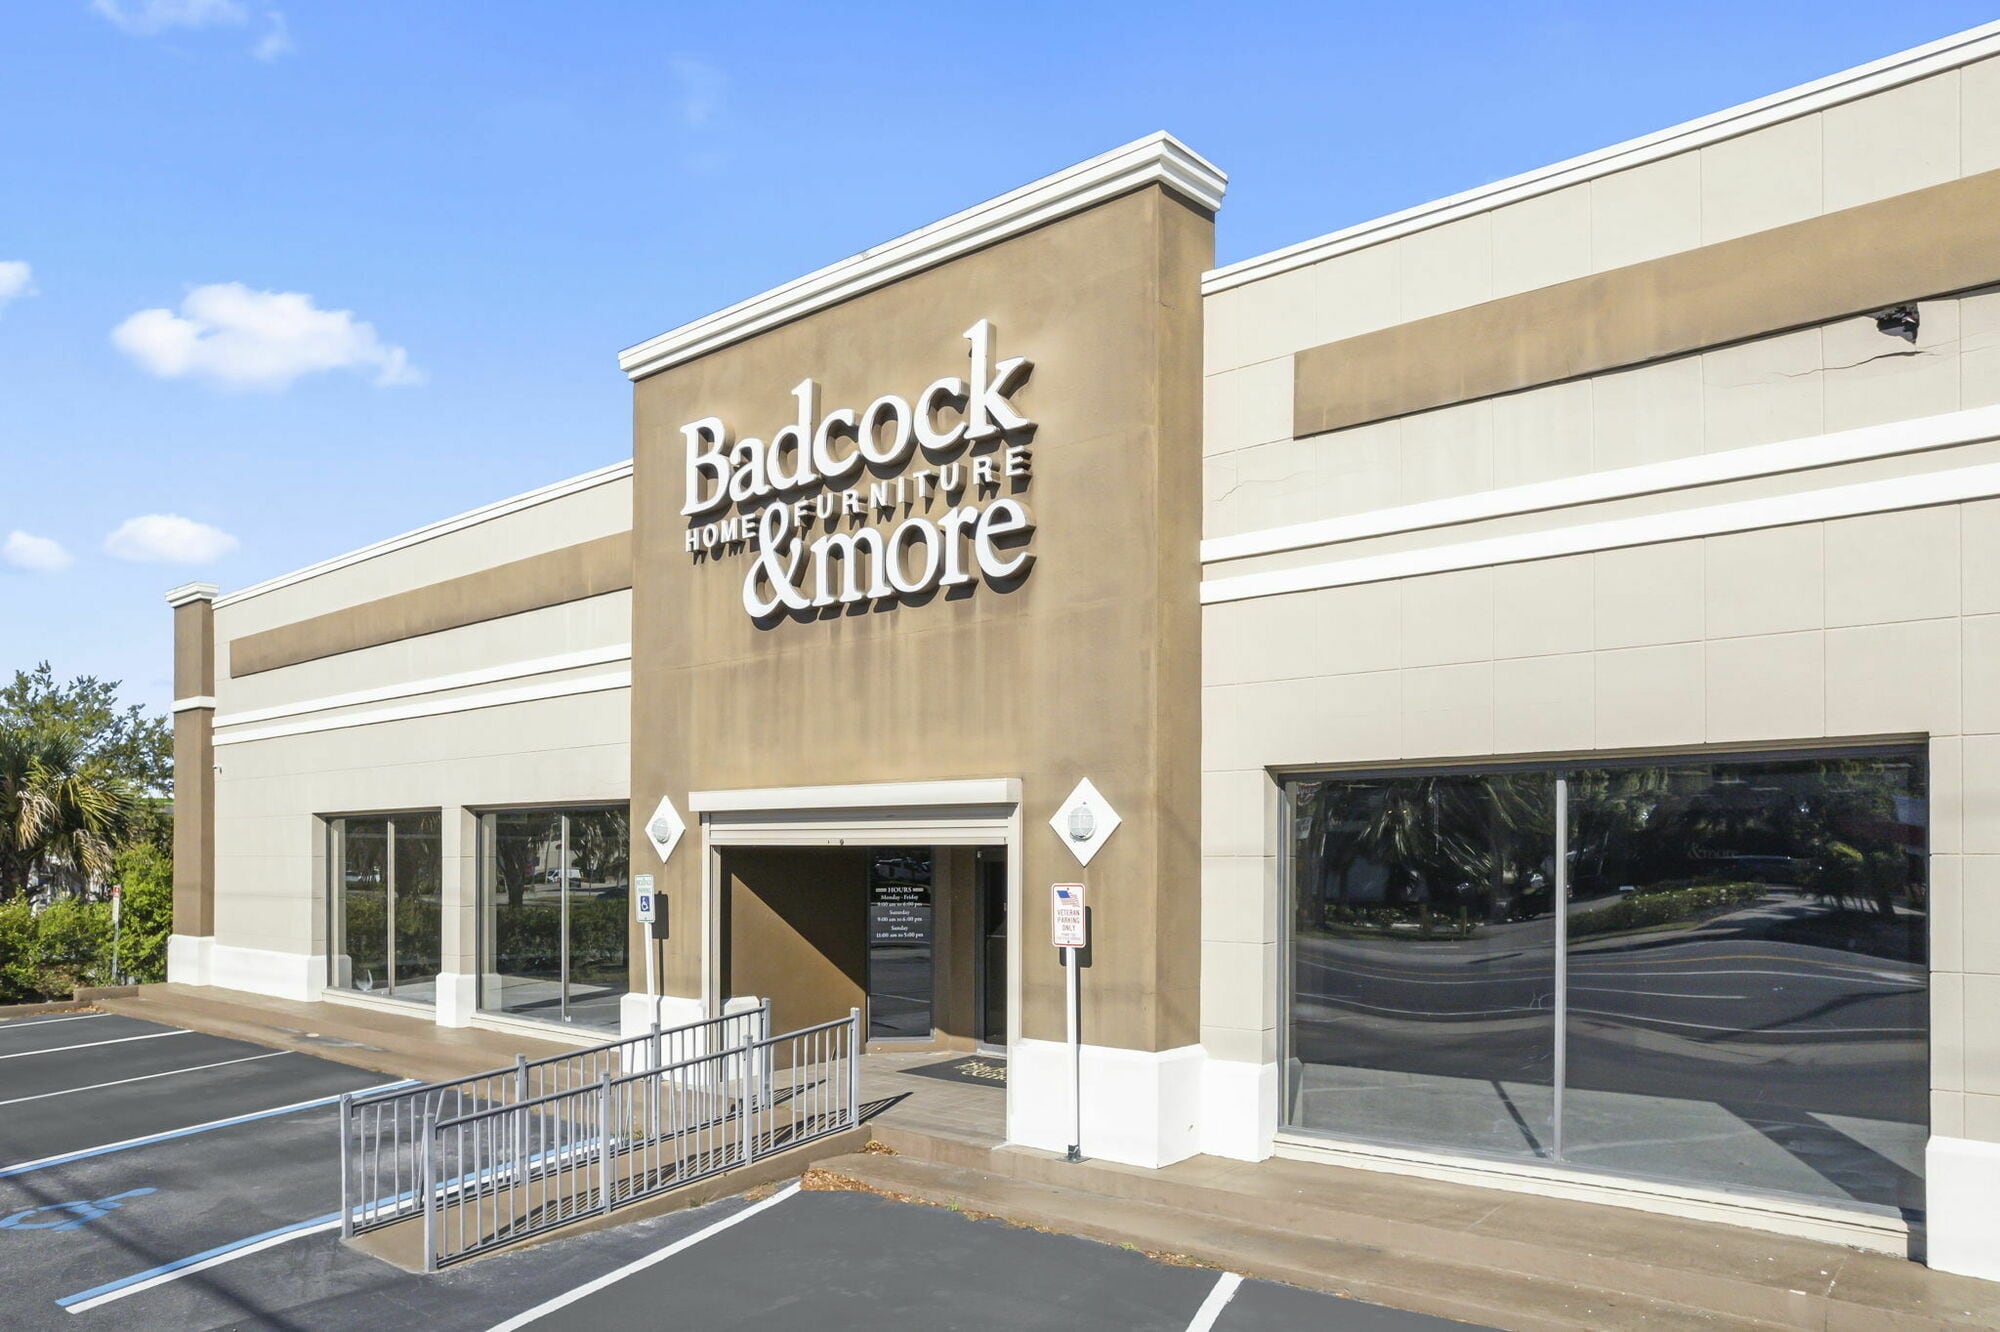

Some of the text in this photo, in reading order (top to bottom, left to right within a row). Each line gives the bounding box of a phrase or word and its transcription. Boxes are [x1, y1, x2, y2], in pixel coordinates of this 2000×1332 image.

[679, 318, 1036, 517] Badcock
[685, 445, 1033, 552] HOME FURNITURE
[742, 498, 1036, 618] &more
